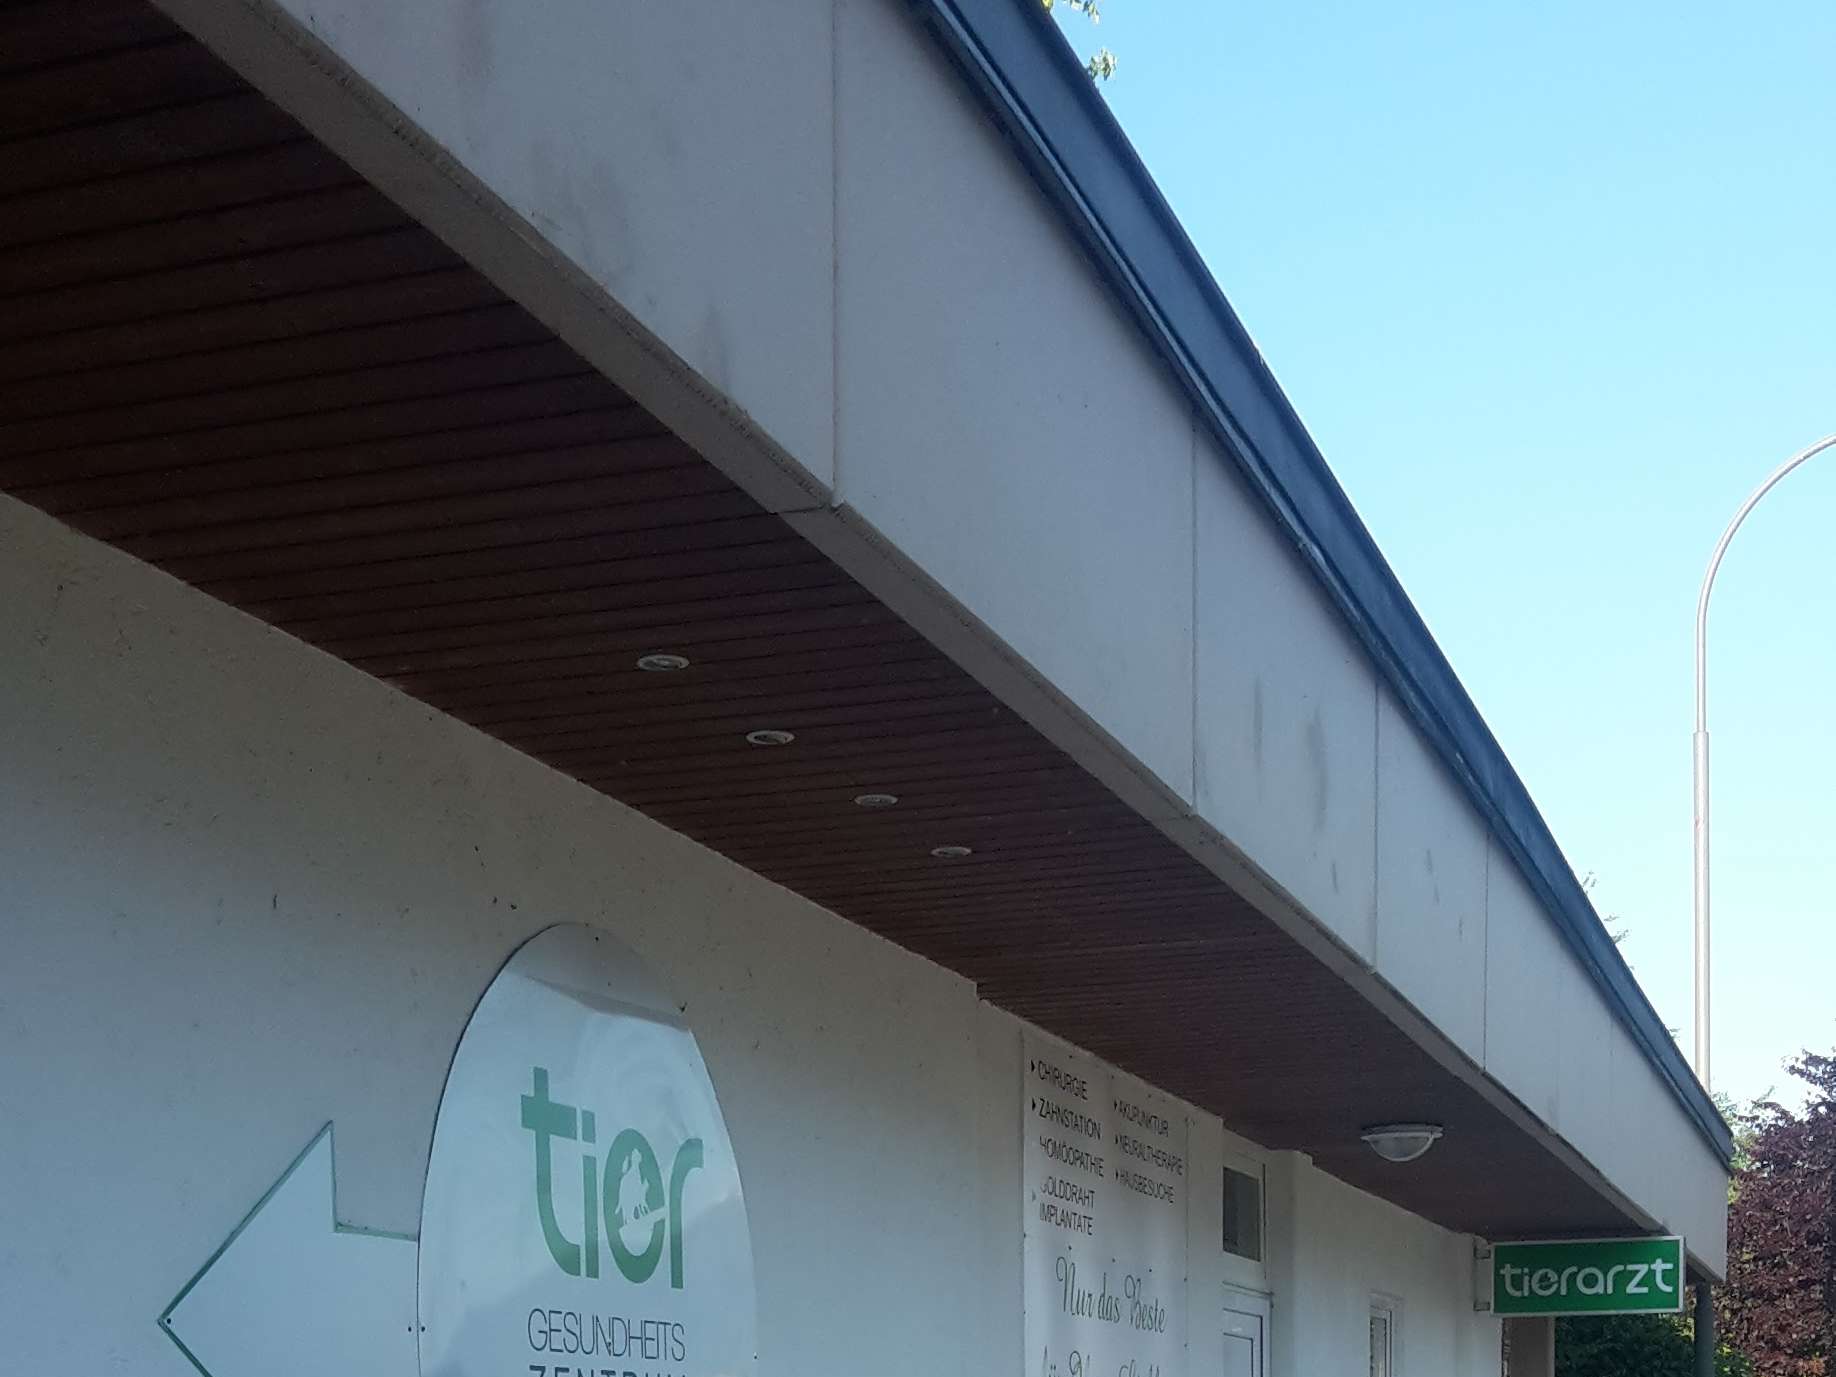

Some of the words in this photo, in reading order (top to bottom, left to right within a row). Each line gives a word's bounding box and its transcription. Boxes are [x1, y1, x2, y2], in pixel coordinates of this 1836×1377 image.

[1038, 1060, 1088, 1100] CHIRURGIE
[1039, 1097, 1101, 1140] ZAHNSTATION
[520, 1066, 704, 1289] tier
[1039, 1202, 1093, 1235] IMPLANTATE
[1056, 1256, 1093, 1318] Nur
[1097, 1272, 1120, 1324] das
[1124, 1274, 1166, 1333] Beste
[1500, 1258, 1674, 1297] tierarzt
[527, 1308, 686, 1362] GESUNDHEITS
